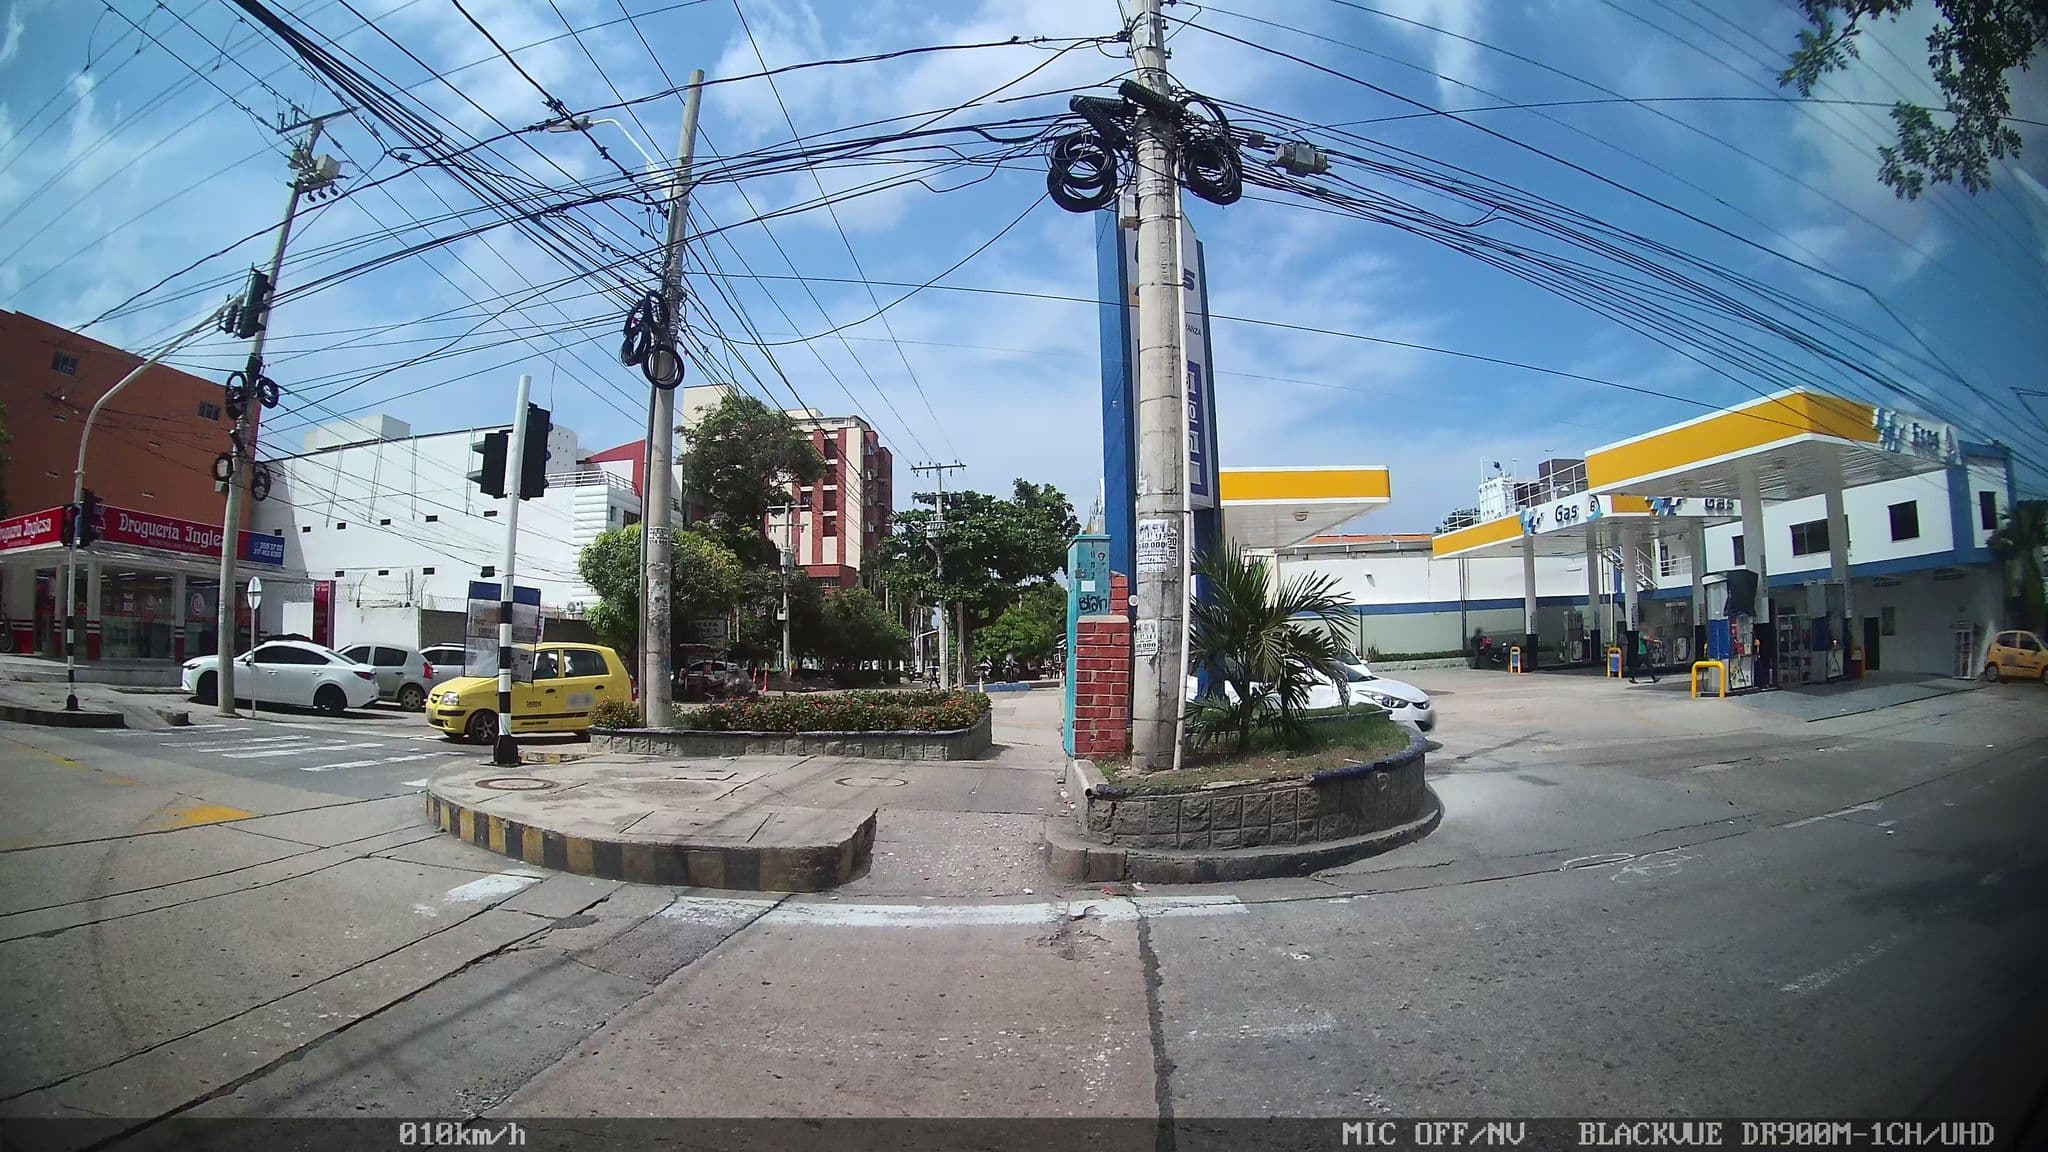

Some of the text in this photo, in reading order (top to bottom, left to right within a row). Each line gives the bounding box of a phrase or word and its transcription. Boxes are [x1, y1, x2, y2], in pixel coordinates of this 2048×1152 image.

[1555, 504, 1578, 522] Gas
[118, 513, 179, 540] Droguería
[184, 525, 224, 548] Ingle
